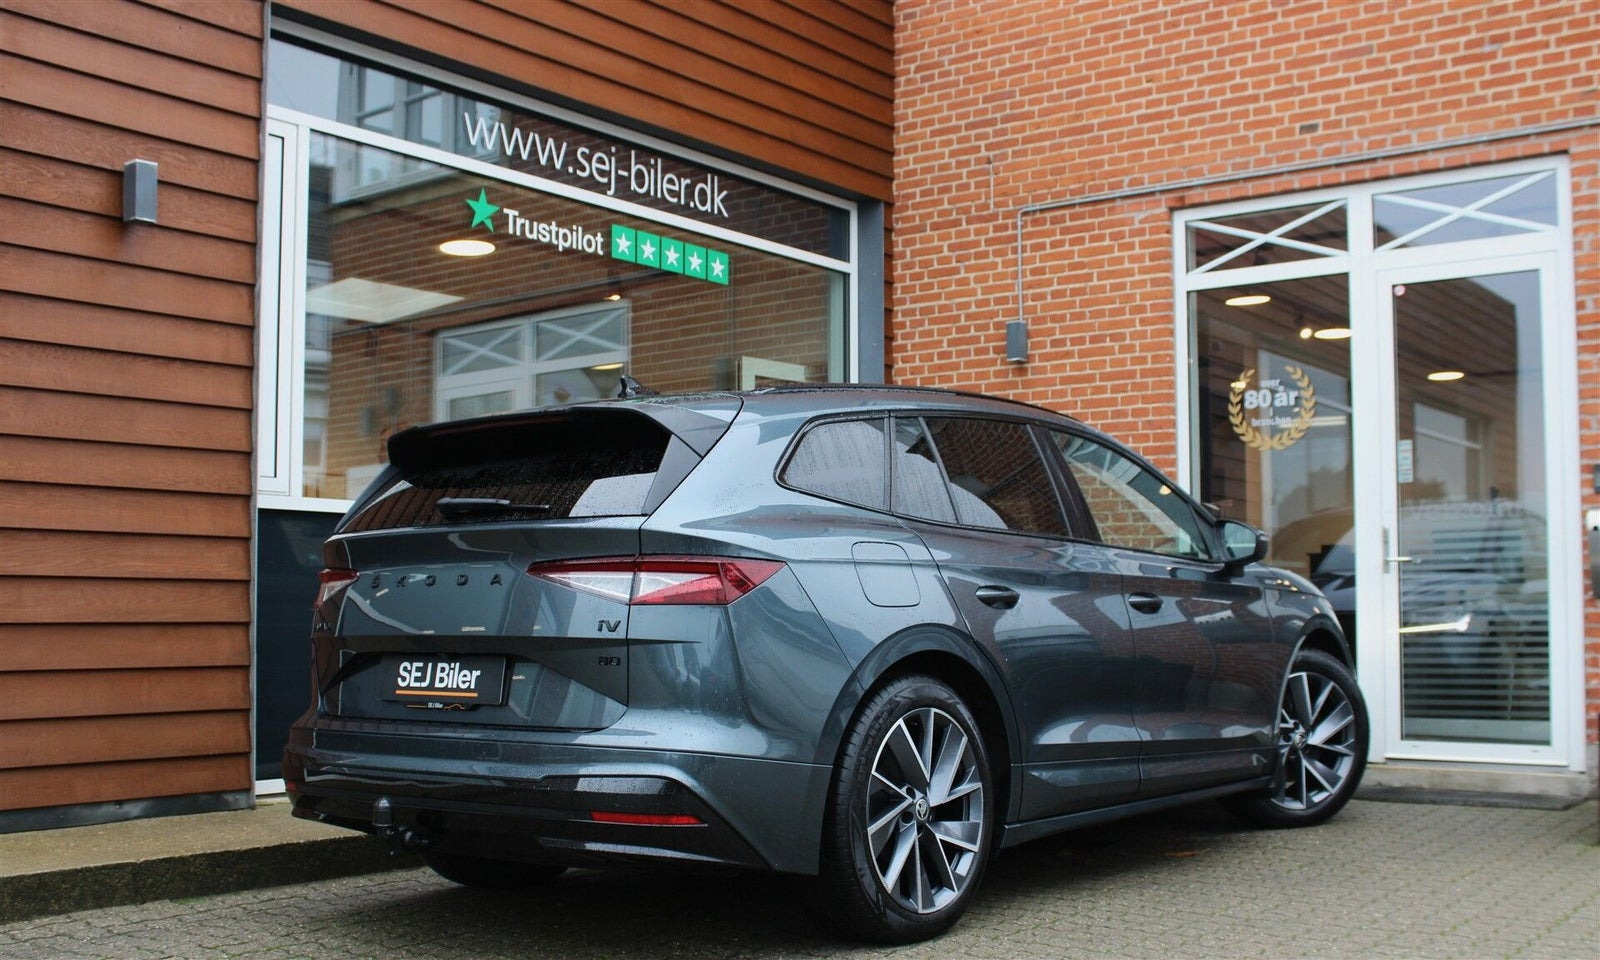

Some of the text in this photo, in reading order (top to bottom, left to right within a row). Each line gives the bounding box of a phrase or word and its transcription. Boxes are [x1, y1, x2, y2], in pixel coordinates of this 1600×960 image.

[464, 111, 729, 218] www.sej-biler.dk
[503, 207, 604, 256] Trustpilot
[1243, 385, 1299, 409] 80 år
[397, 661, 481, 689] SEJ Biler
